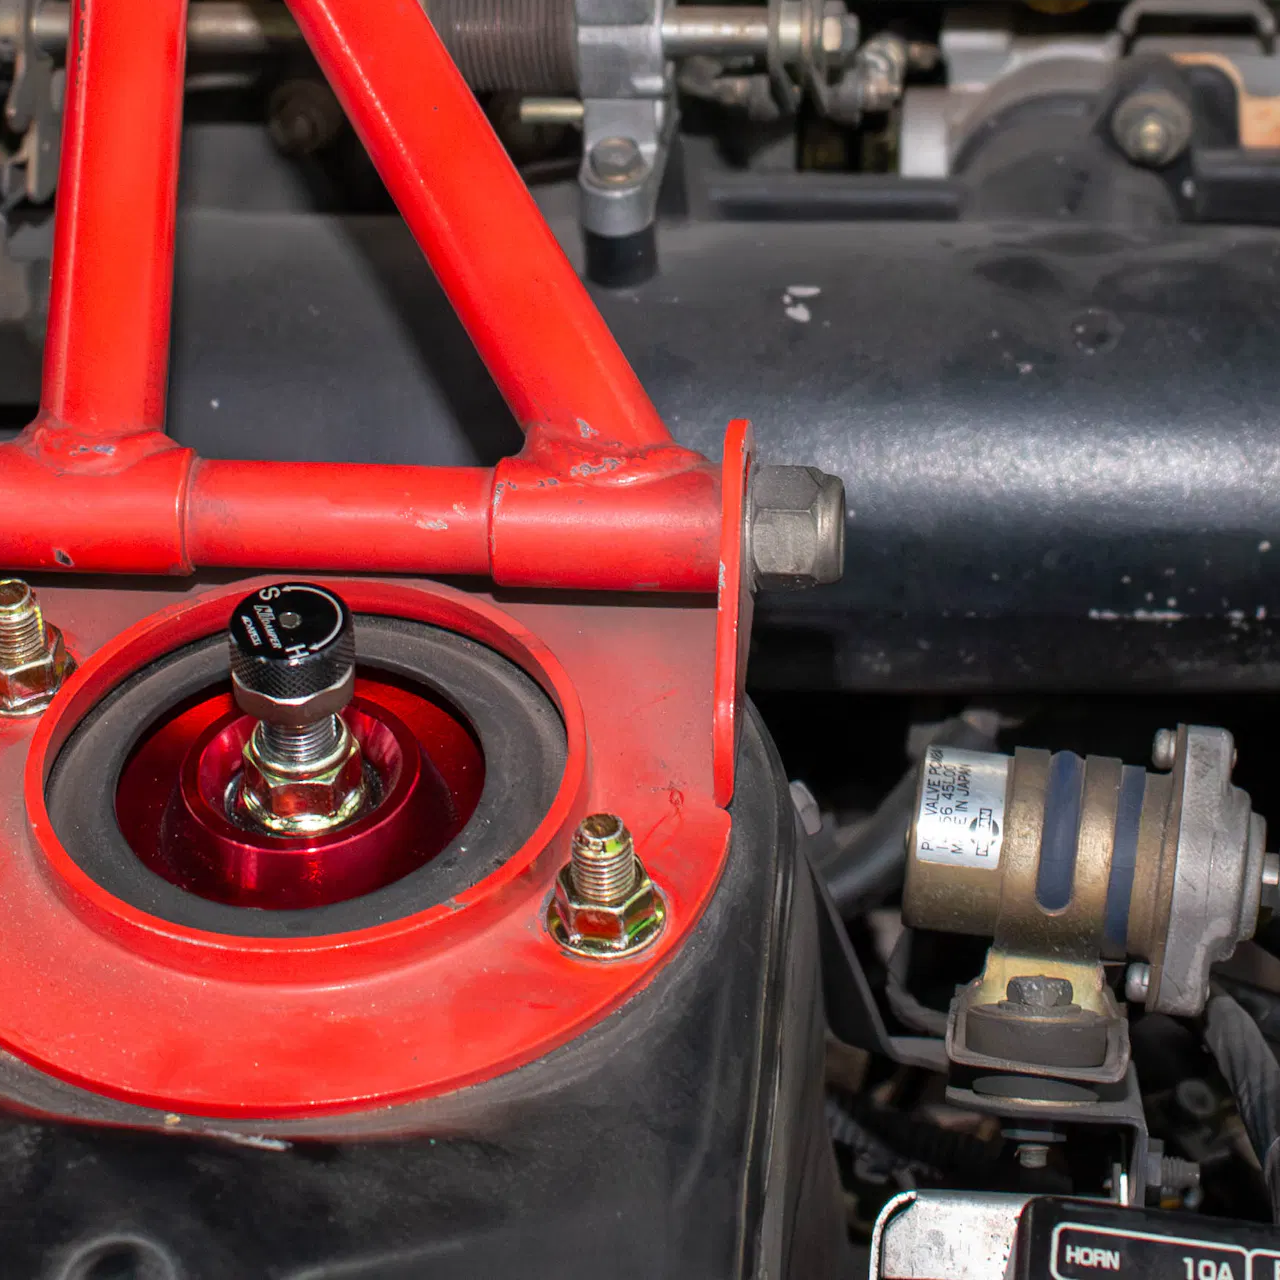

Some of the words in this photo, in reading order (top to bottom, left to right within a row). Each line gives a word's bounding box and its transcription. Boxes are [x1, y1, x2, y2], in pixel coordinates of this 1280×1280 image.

[259, 586, 281, 601] S
[285, 643, 310, 661] H
[924, 778, 942, 816] VALVE
[955, 800, 968, 812] IN
[951, 815, 966, 855] ME
[1065, 1245, 1120, 1271] HORN
[1182, 1256, 1232, 1280] 10A
